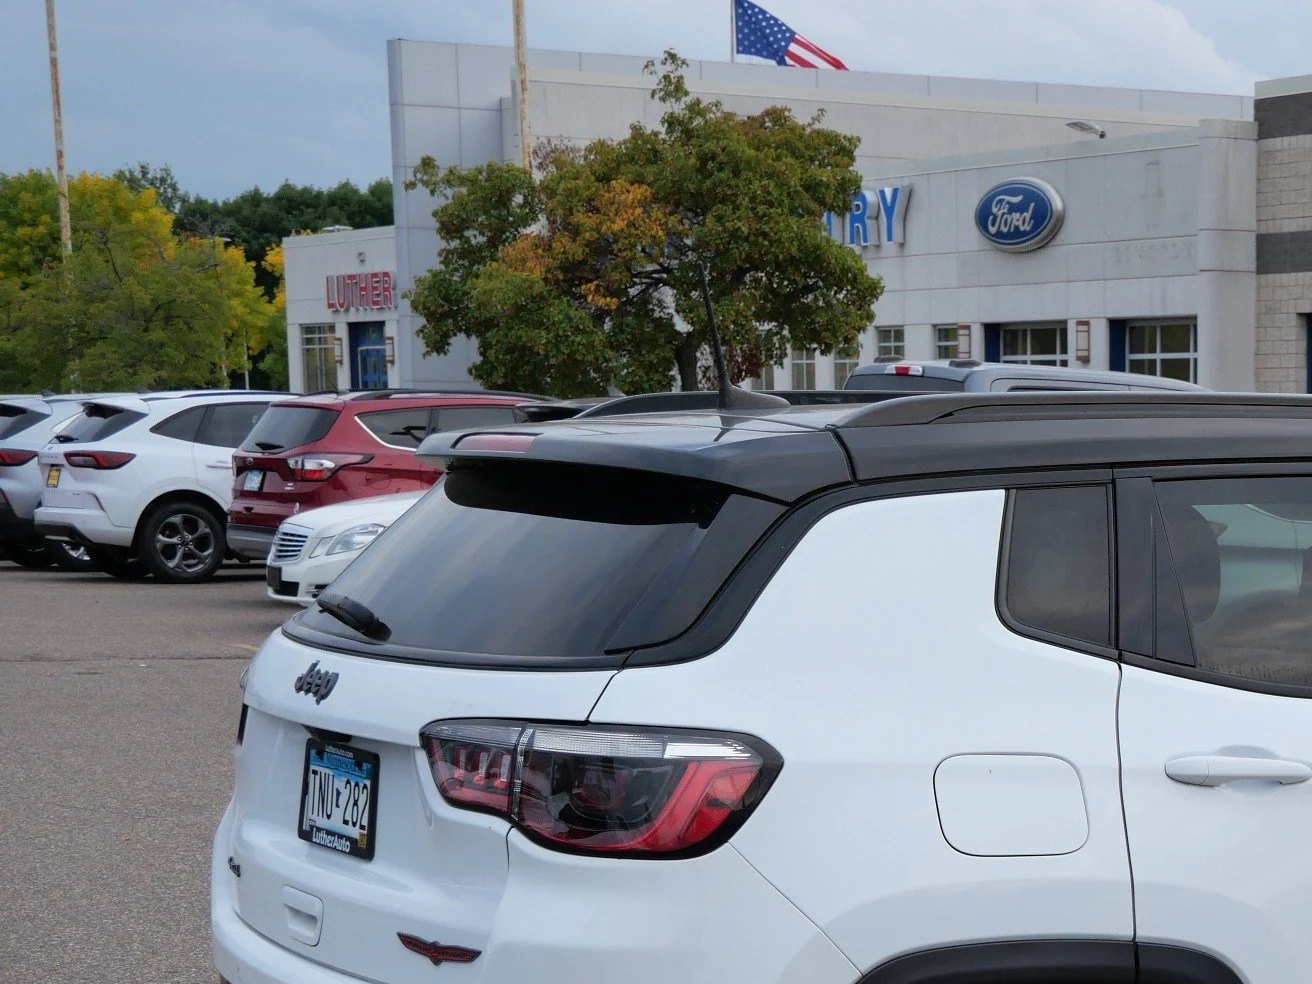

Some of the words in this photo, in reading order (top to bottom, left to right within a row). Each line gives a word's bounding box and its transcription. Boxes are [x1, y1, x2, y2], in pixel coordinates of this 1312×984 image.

[988, 195, 1035, 235] Ford
[326, 271, 394, 310] LUTHER
[294, 659, 340, 706] Jeep
[312, 769, 334, 820] TNU
[342, 779, 369, 831] 282
[312, 827, 351, 853] LutherAuto
